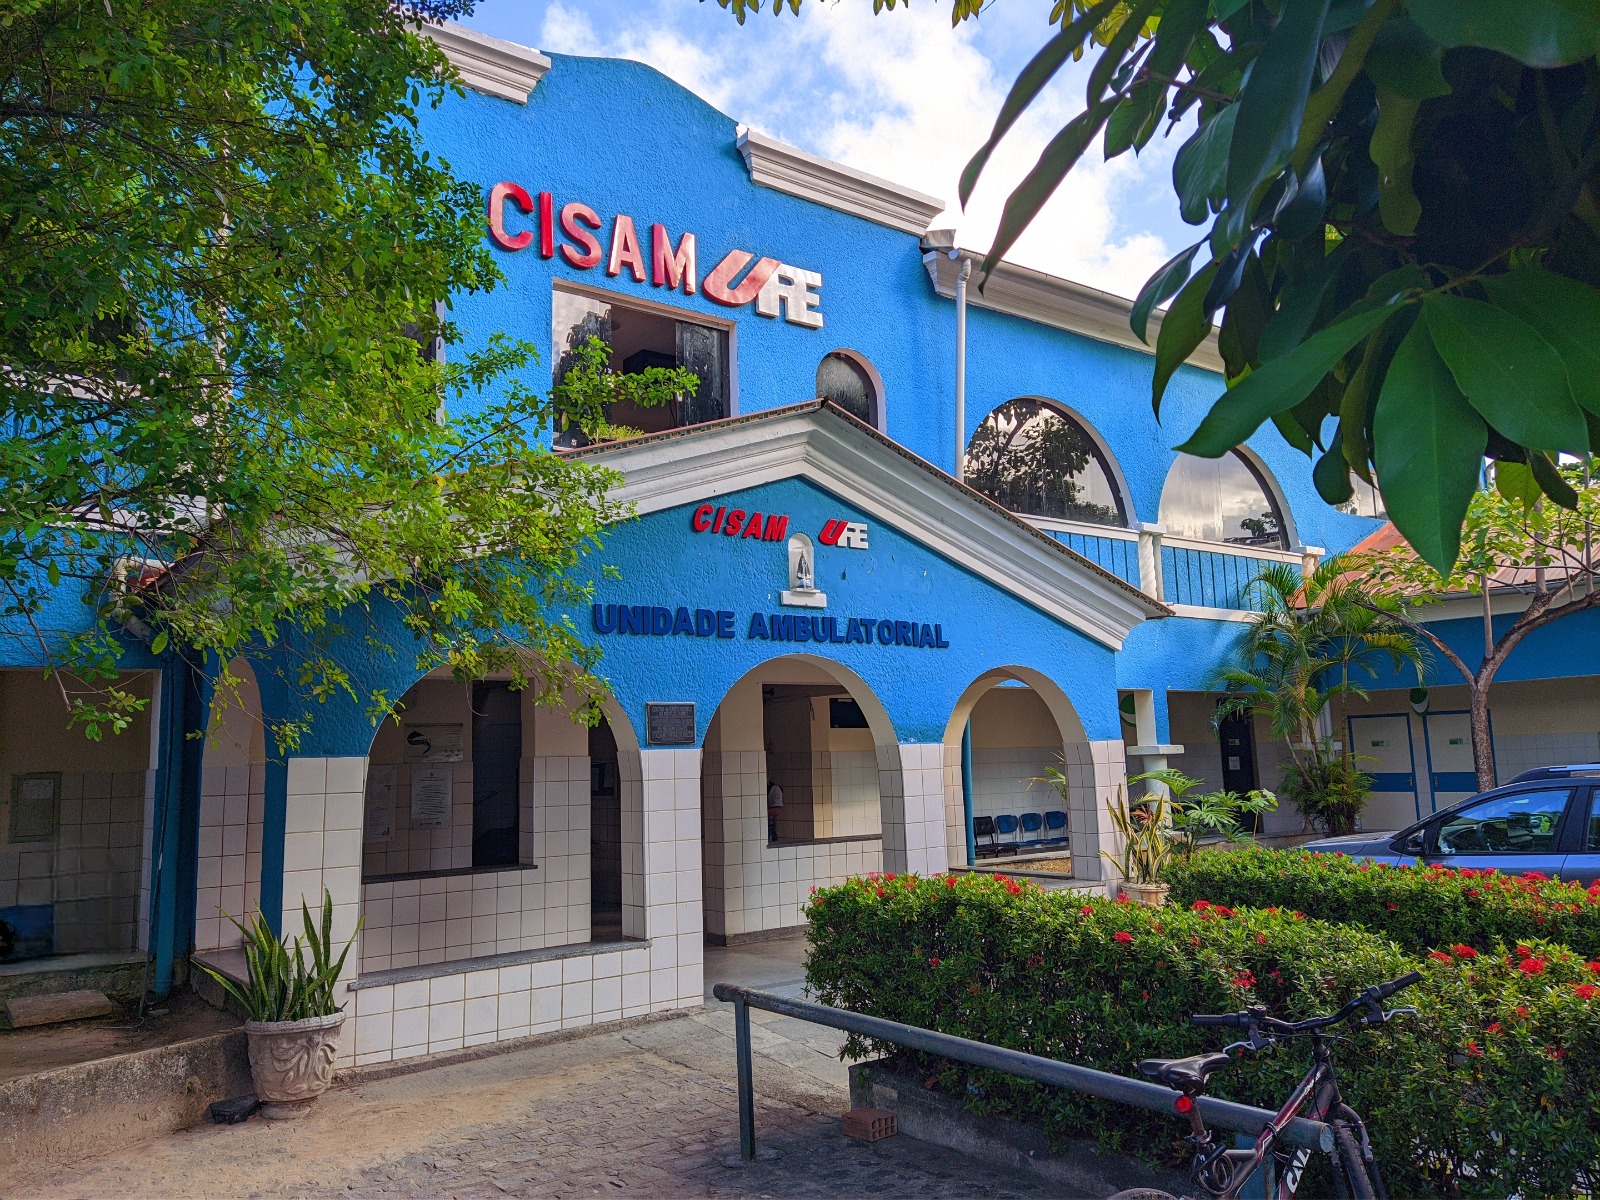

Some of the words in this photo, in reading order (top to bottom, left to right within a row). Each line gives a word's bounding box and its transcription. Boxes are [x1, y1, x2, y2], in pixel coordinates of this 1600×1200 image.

[488, 181, 696, 295] CISAM
[693, 503, 789, 542] CISAM
[593, 603, 735, 638] UNIDADE
[749, 612, 949, 649] AMBULATORIAL
[1286, 1148, 1311, 1194] CAL
